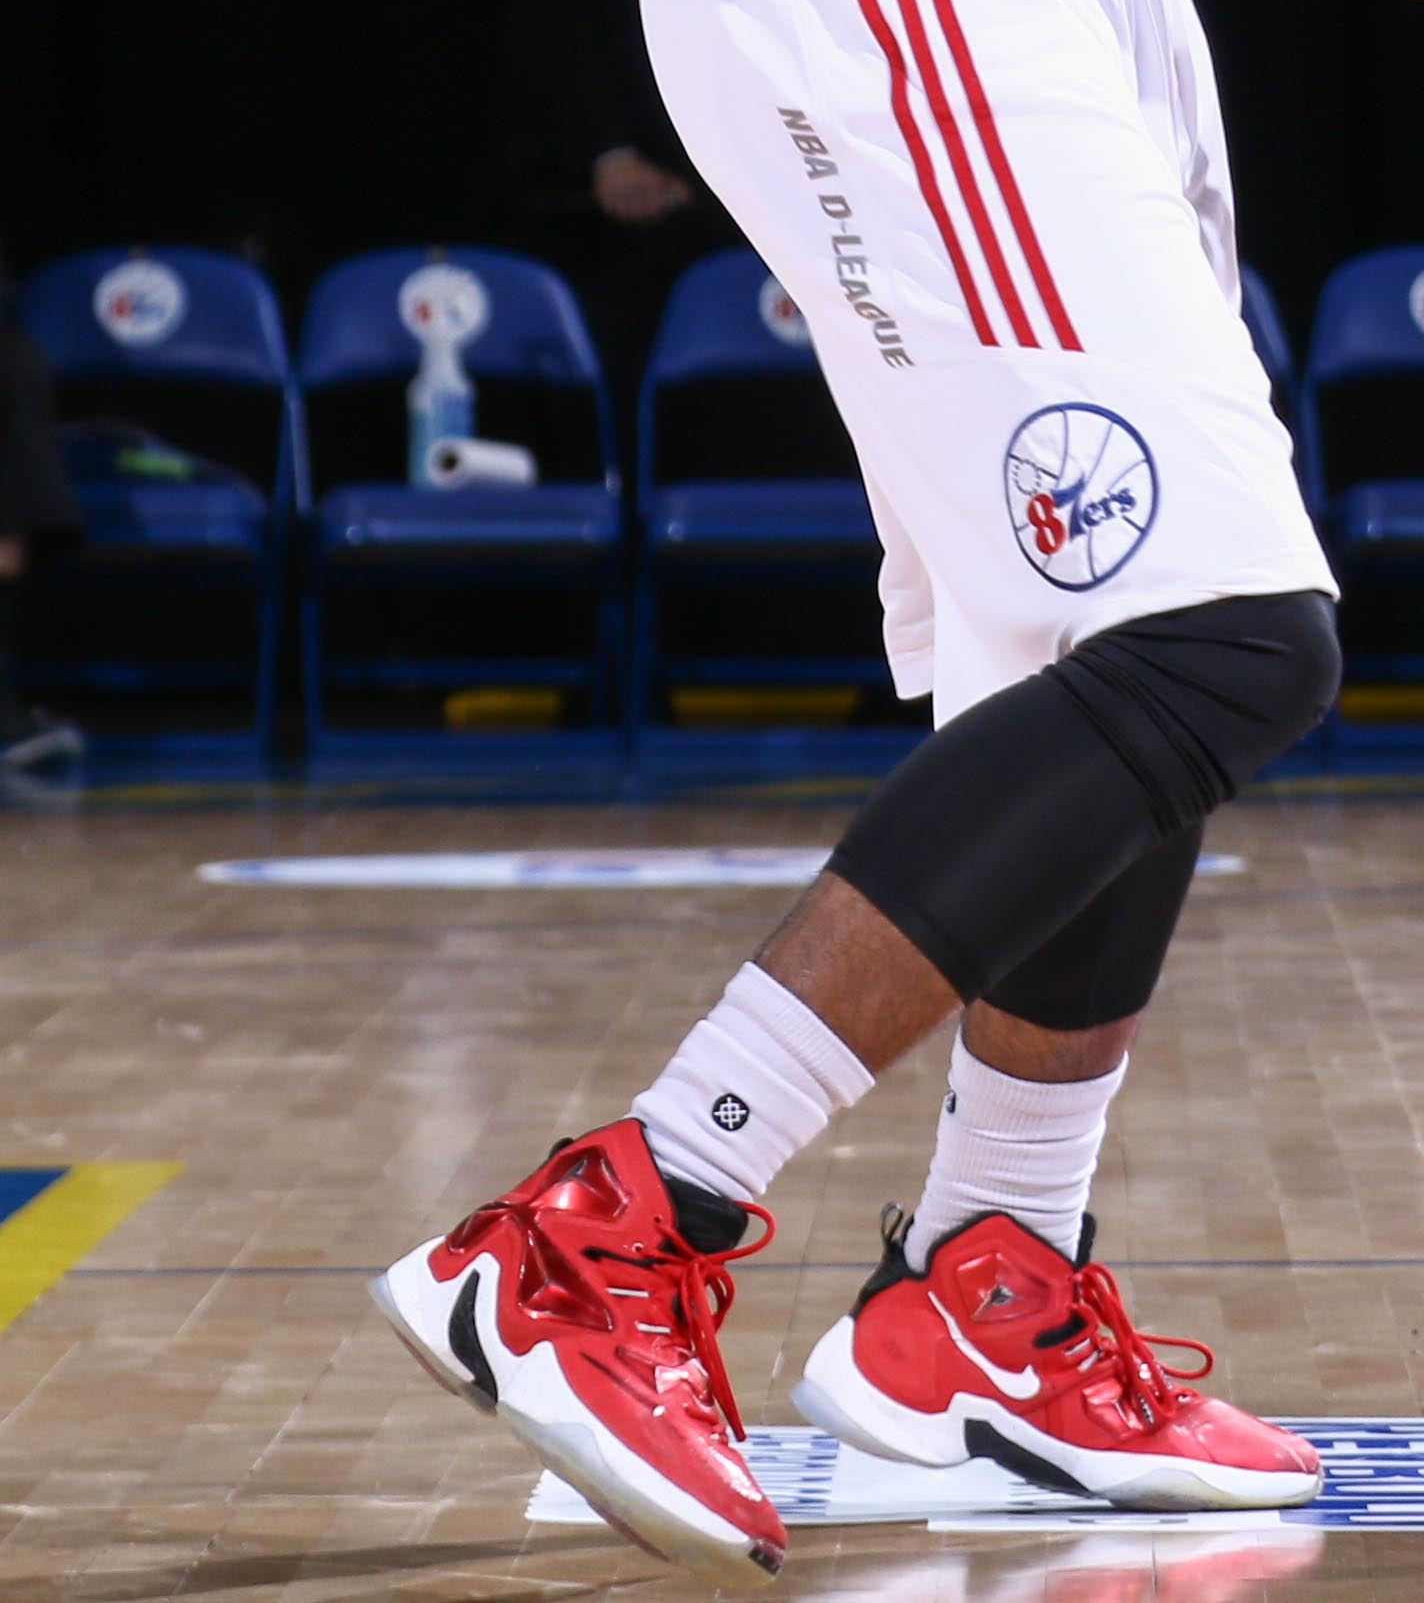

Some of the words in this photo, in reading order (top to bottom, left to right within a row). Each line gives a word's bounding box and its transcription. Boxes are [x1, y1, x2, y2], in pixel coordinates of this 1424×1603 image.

[777, 107, 839, 180] NBA
[818, 194, 916, 370] D-LEAGUE
[1027, 471, 1136, 555] 87ers
